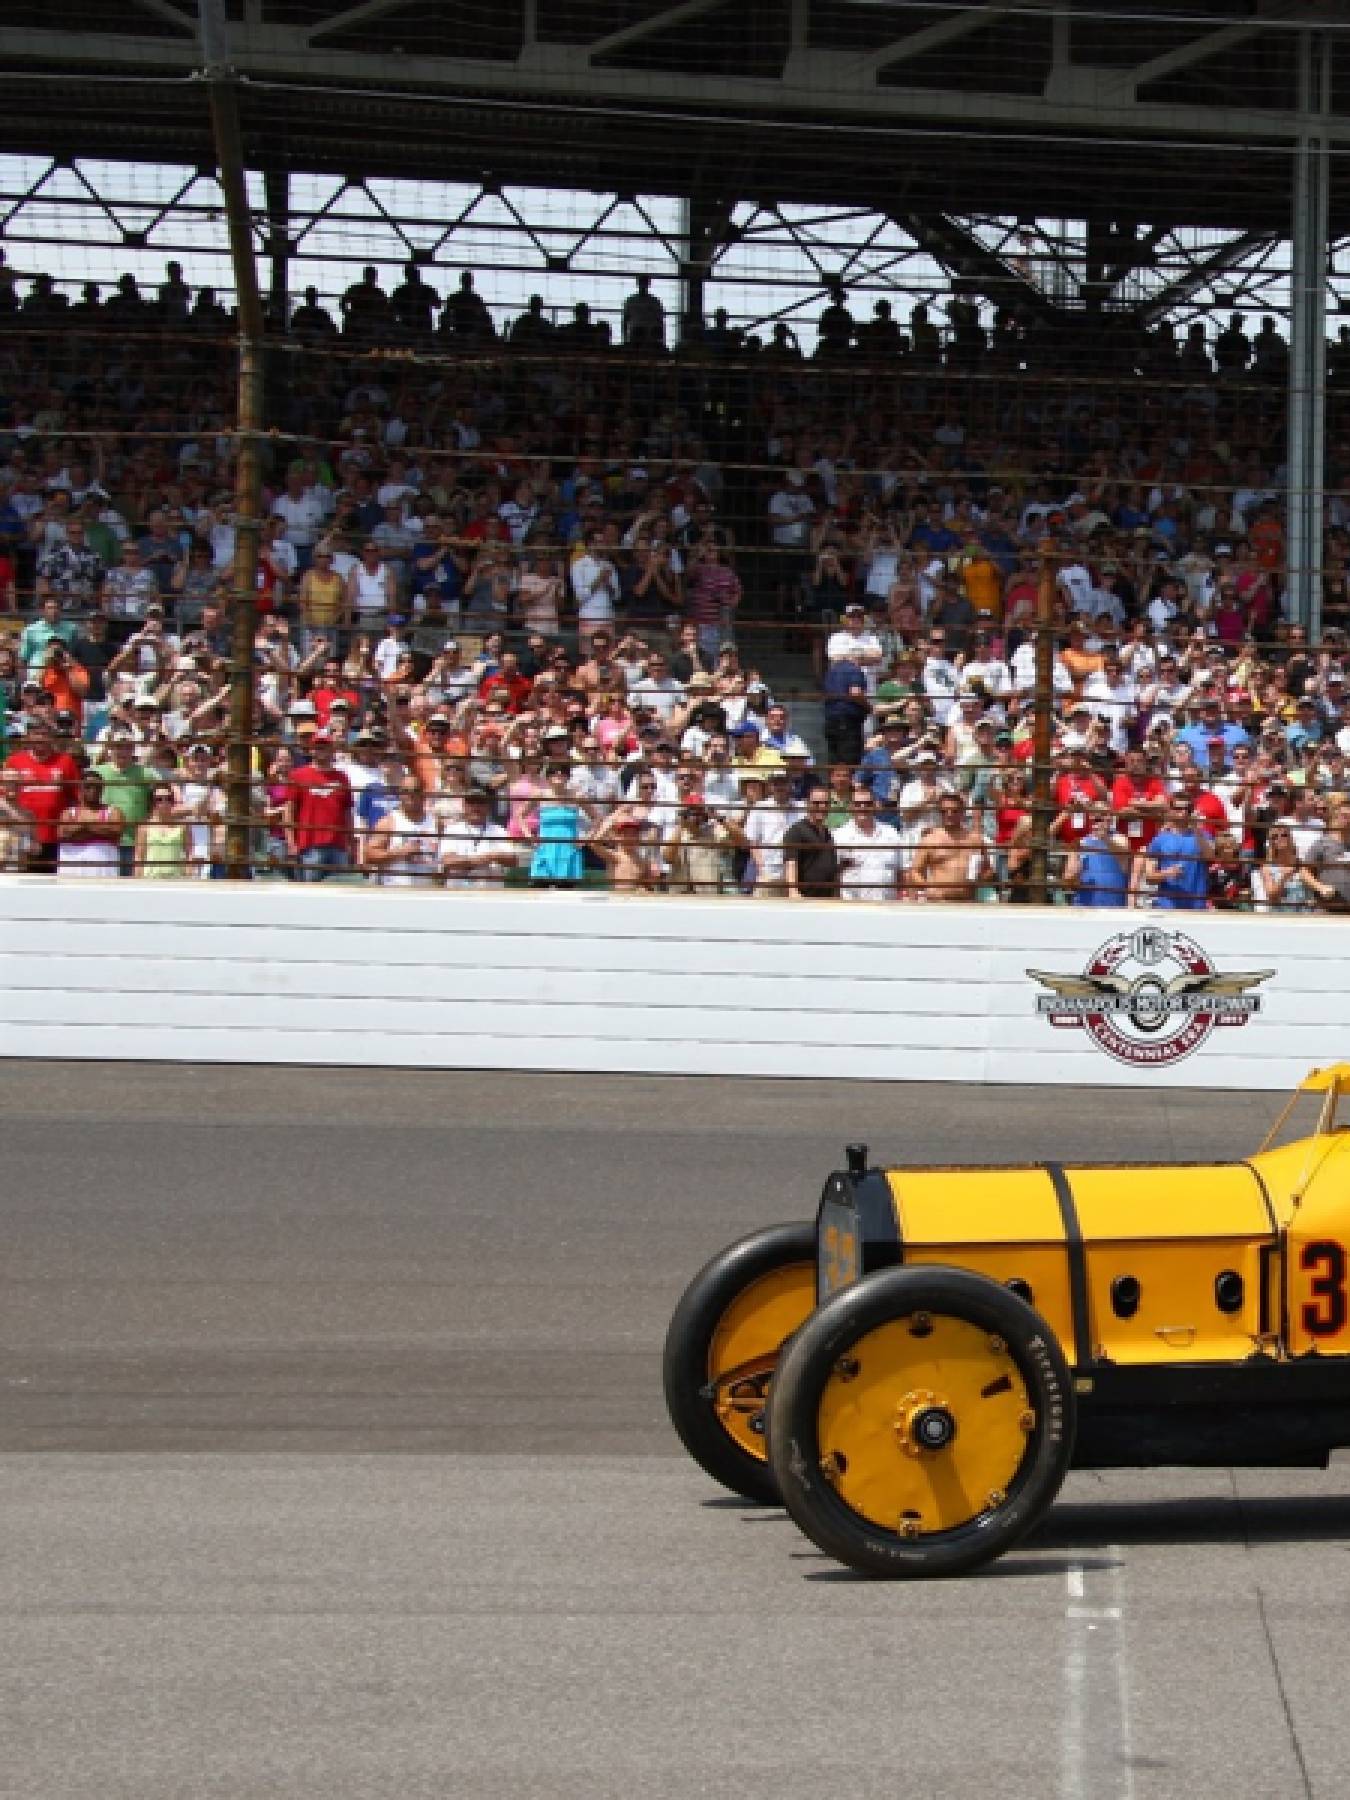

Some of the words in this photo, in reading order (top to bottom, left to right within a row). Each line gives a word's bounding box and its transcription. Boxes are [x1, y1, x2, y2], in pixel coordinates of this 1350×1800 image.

[1040, 996, 1131, 1012] INDIANAPOLIS
[1138, 996, 1182, 1012] MOTOR
[1187, 997, 1257, 1012] SPEEDWAY
[1094, 1022, 1180, 1062] CENTENNIAL
